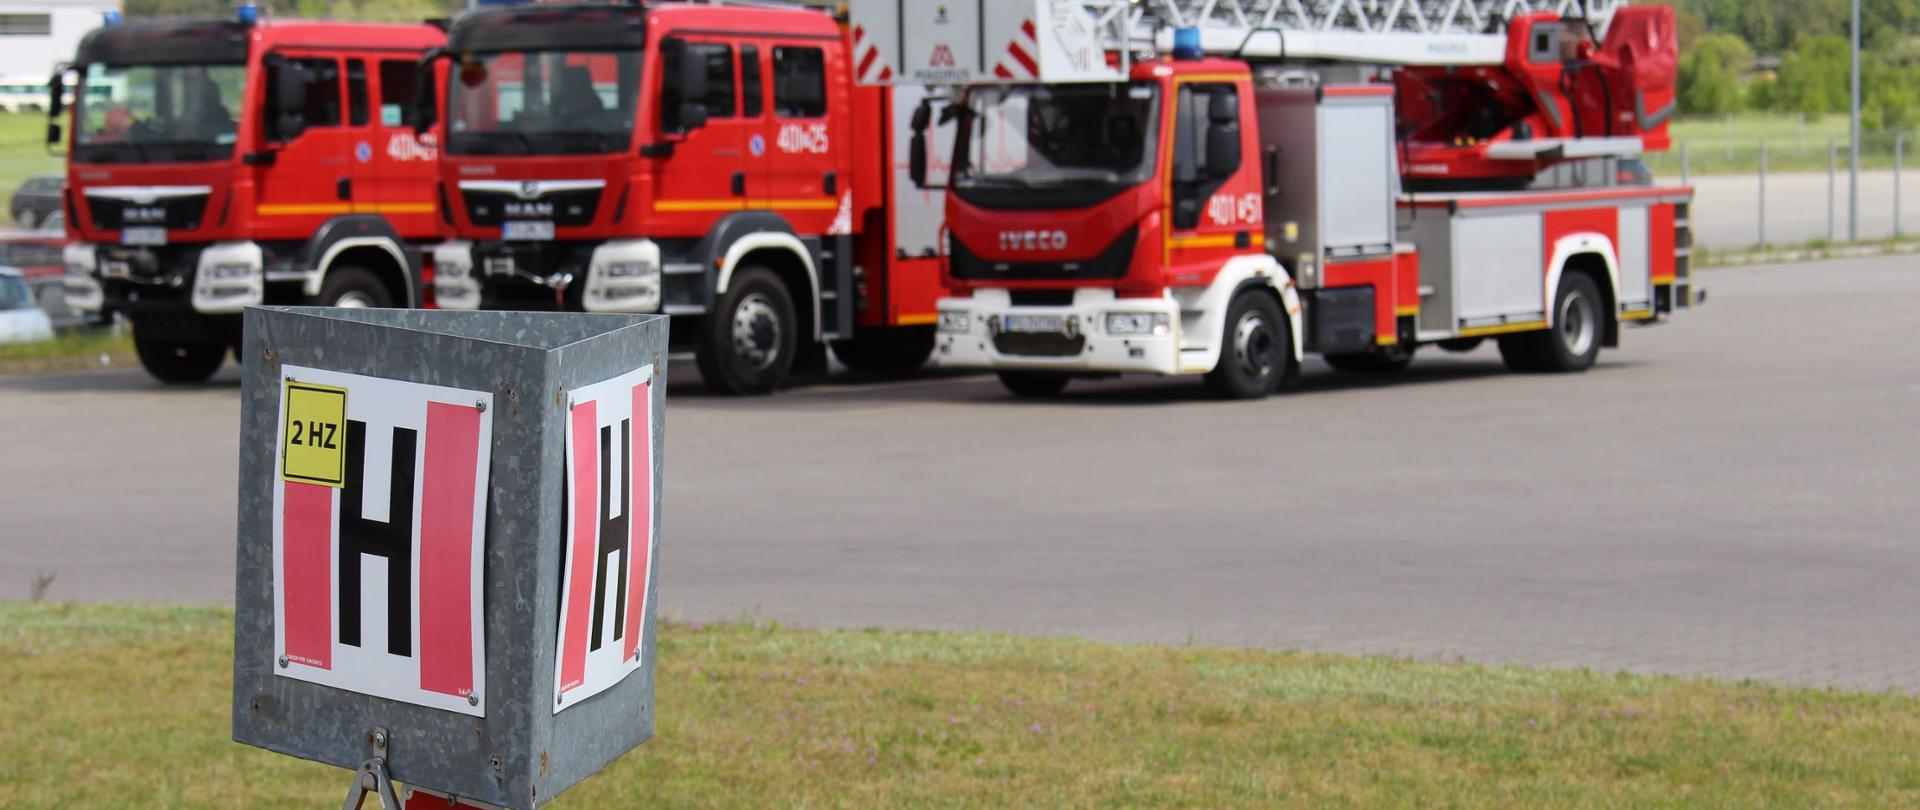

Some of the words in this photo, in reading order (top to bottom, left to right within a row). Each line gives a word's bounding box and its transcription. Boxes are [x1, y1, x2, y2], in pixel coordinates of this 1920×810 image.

[122, 206, 167, 222] MAN
[504, 202, 554, 217] MAN
[999, 230, 1068, 251] IVECO
[291, 419, 304, 446] 2
[308, 420, 338, 450] HZ
[338, 418, 418, 658] H
[589, 417, 631, 653] H
